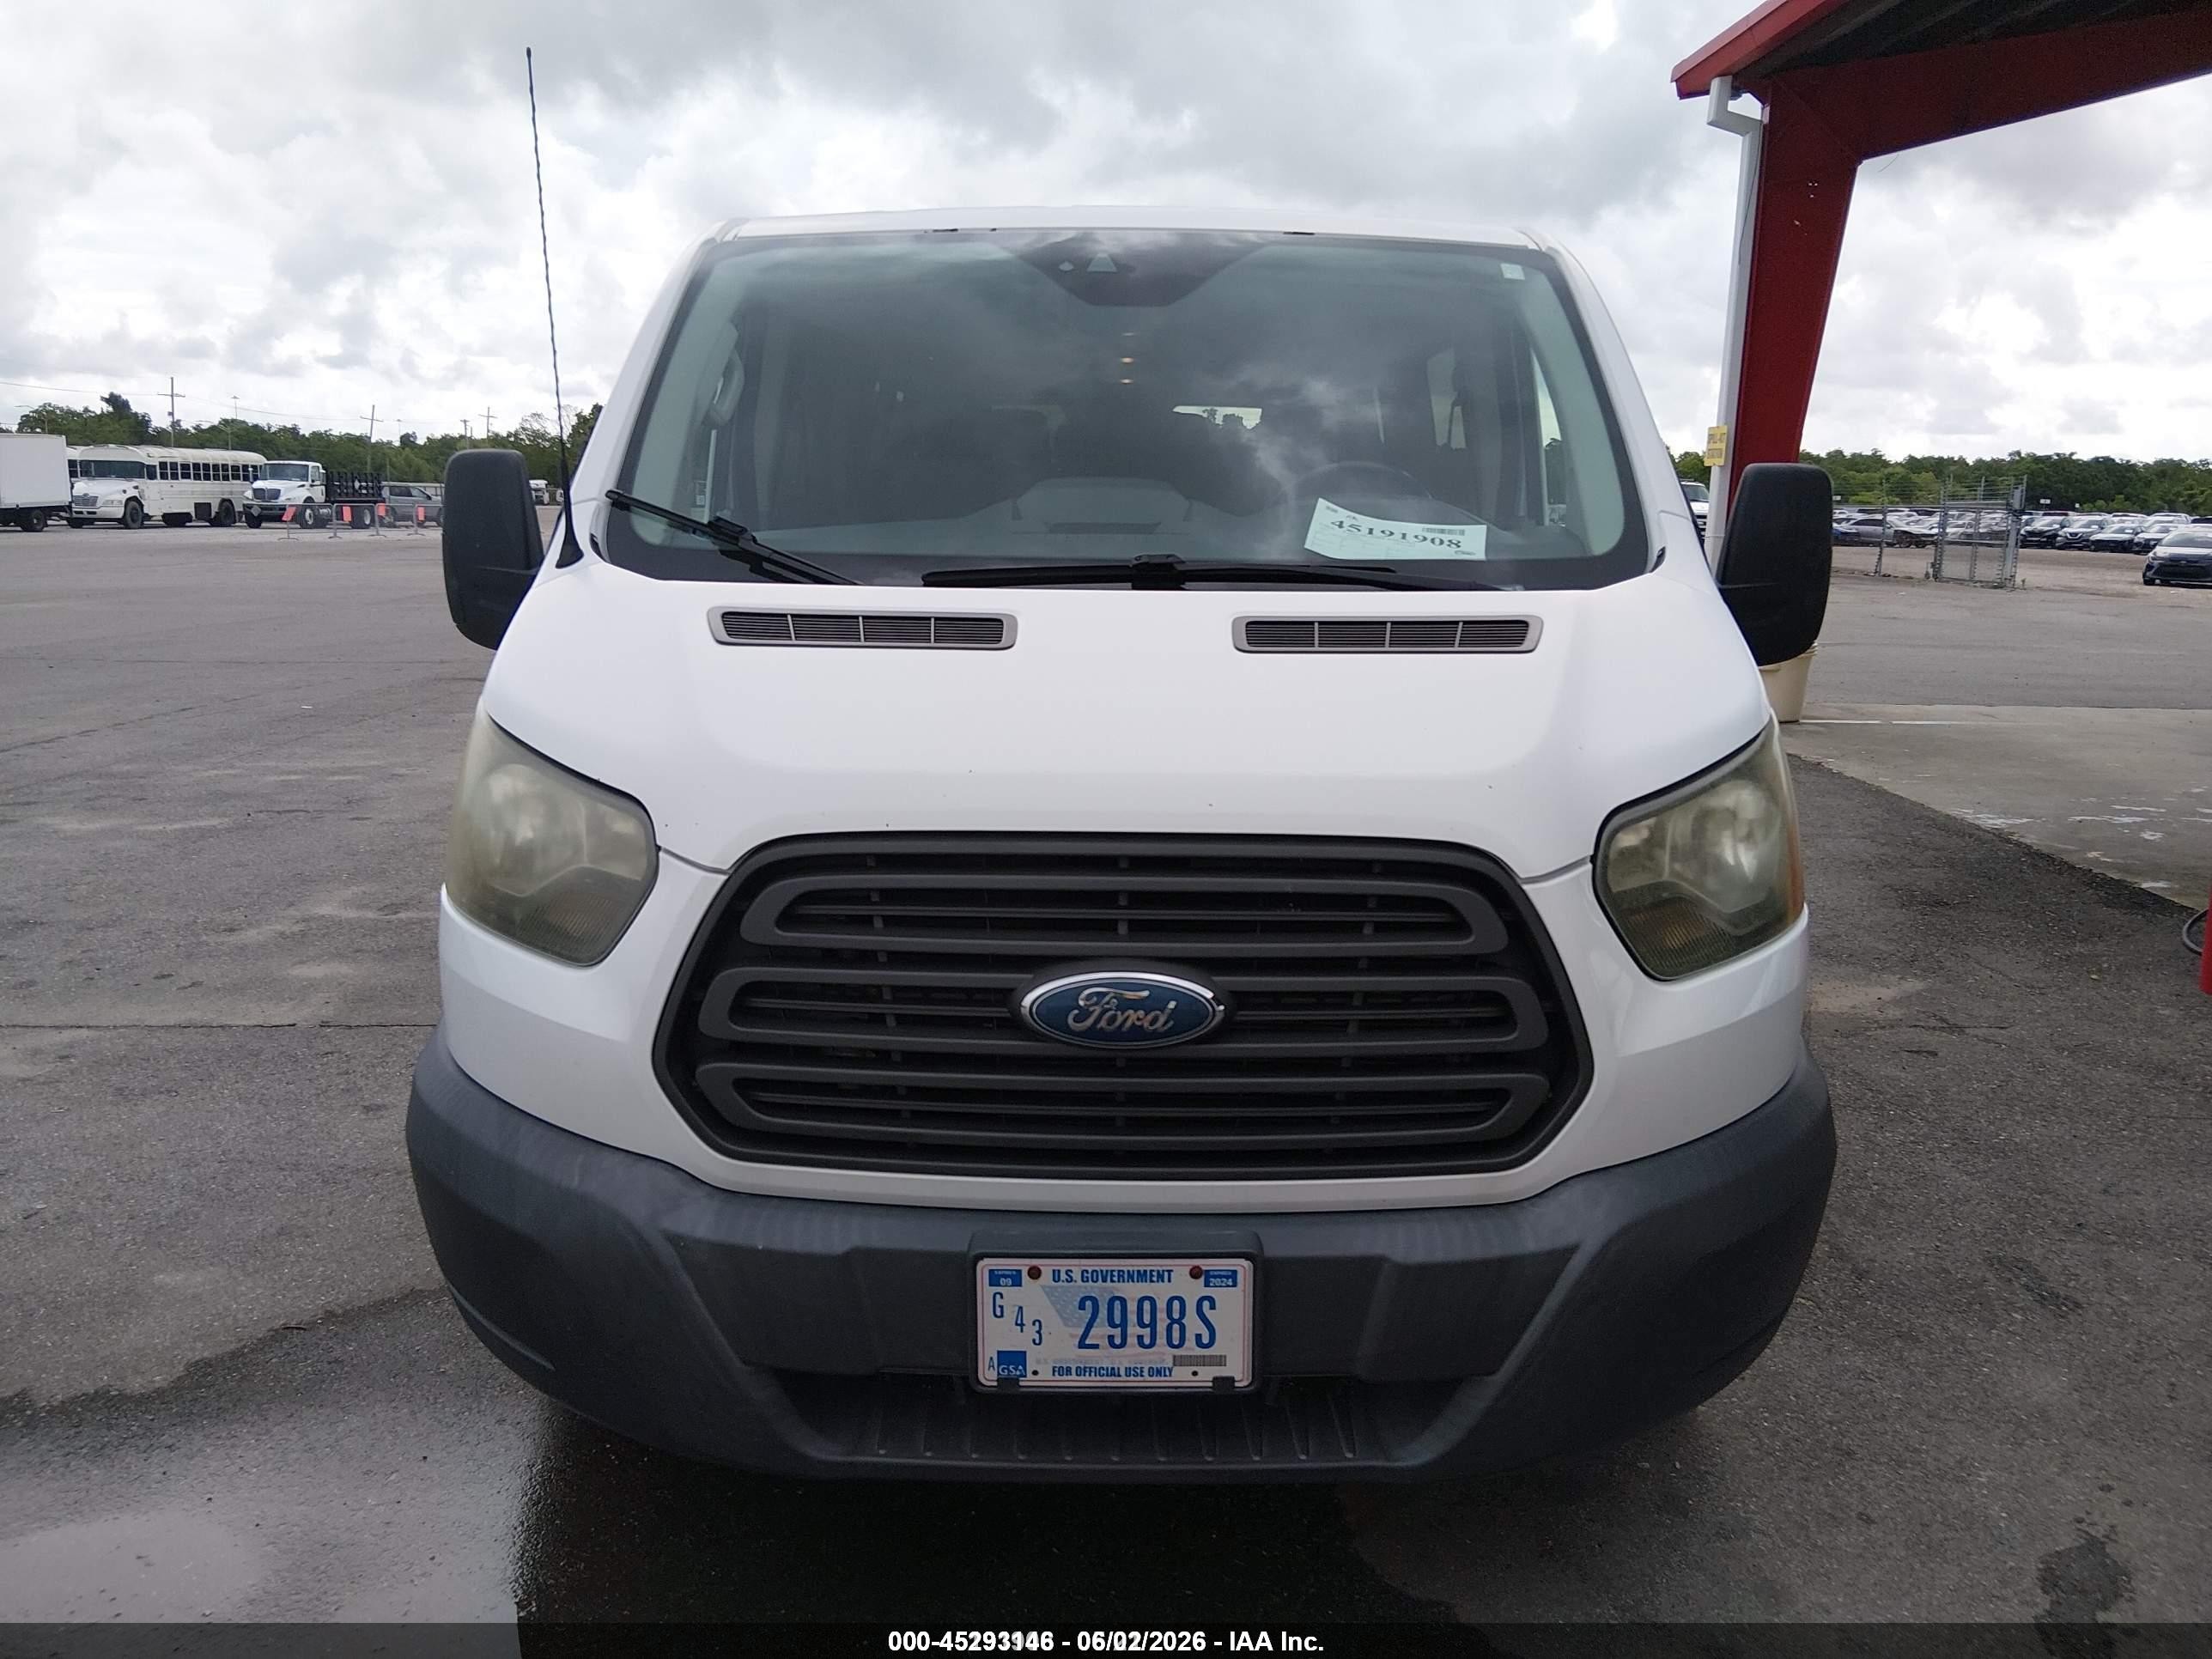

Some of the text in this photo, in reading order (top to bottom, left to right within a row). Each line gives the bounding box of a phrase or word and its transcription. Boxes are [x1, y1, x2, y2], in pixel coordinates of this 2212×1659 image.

[1330, 519, 1462, 550] 45191908
[1066, 986, 1177, 1032] Ford
[1052, 1268, 1174, 1283] U.S. GOVERNMENT
[1209, 1278, 1233, 1286] 2024
[1077, 1294, 1218, 1350] 2998S
[999, 1364, 1026, 1376] GSA
[1052, 1365, 1174, 1377] FOR OFFICIAL USE ONLY
